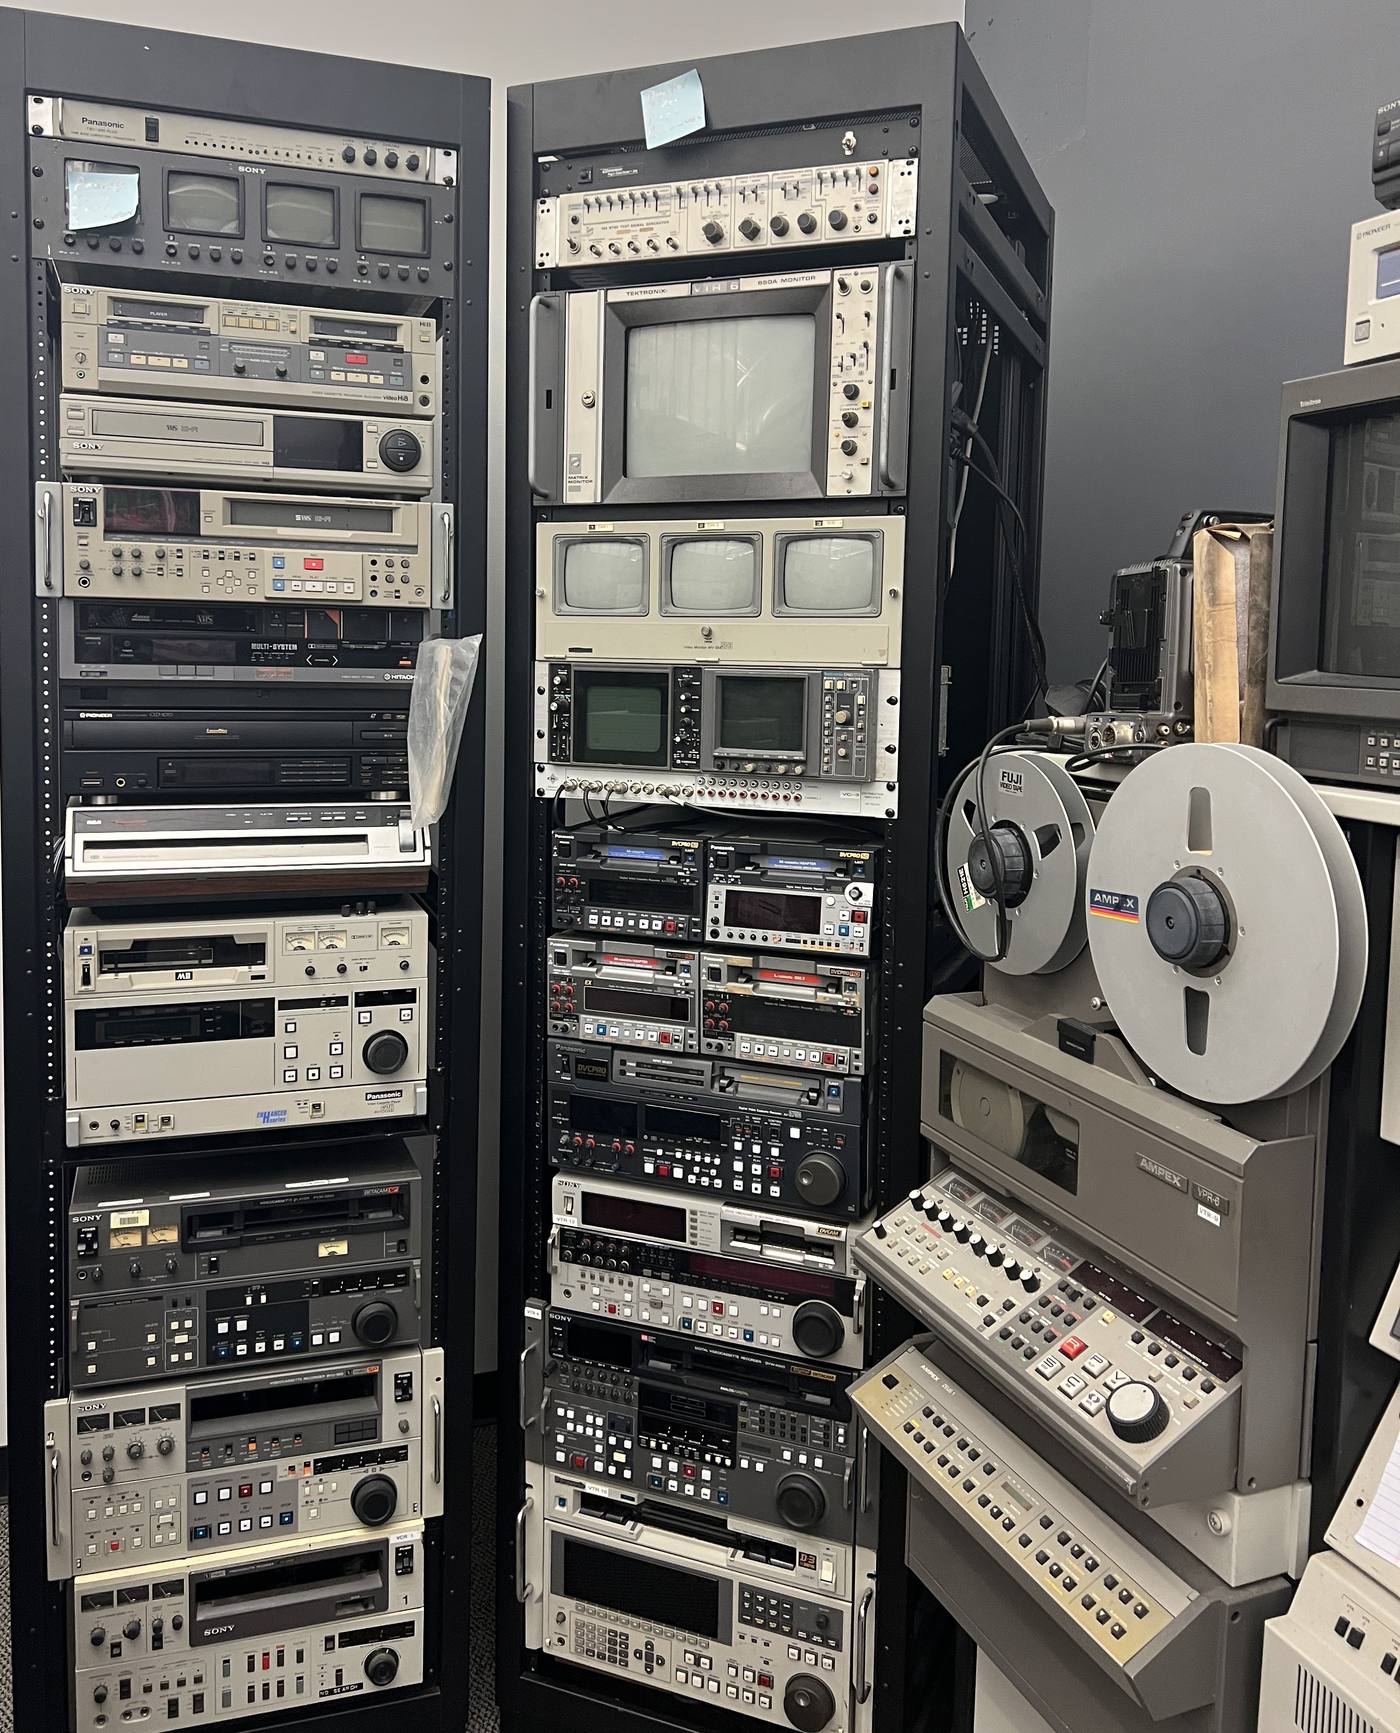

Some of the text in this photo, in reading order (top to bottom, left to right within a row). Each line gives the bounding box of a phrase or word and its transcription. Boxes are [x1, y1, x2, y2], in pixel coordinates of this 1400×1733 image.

[81, 116, 125, 129] Panasonic
[238, 165, 266, 174] SONY
[1361, 224, 1391, 238] PIONEER
[780, 275, 817, 284] MONITOR
[64, 286, 95, 296] SONY
[626, 288, 667, 297] TEKTRONIX
[72, 441, 104, 450] SONY
[69, 485, 102, 494] SONY
[251, 642, 298, 651] MULTI-SYSTEM
[1001, 771, 1023, 786] FUJI
[1000, 783, 1023, 793] VIDEO TAPE
[1094, 892, 1135, 909] AMPX
[555, 1043, 586, 1054] Panasonic
[577, 1063, 607, 1074] DVCPRO
[366, 1091, 402, 1100] Panasonic
[1140, 1158, 1182, 1187] AMPEX
[364, 1188, 389, 1197] BETACAM
[72, 1213, 103, 1224] SONY
[819, 1228, 841, 1237] DVCAM
[550, 1313, 572, 1322] SONY
[920, 1364, 940, 1381] AMPEX
[78, 1402, 108, 1413] SONY
[799, 1553, 816, 1565] D-3
[402, 1594, 409, 1606] 1
[203, 1624, 236, 1637] SONY
[333, 1684, 359, 1695] SEARCH
